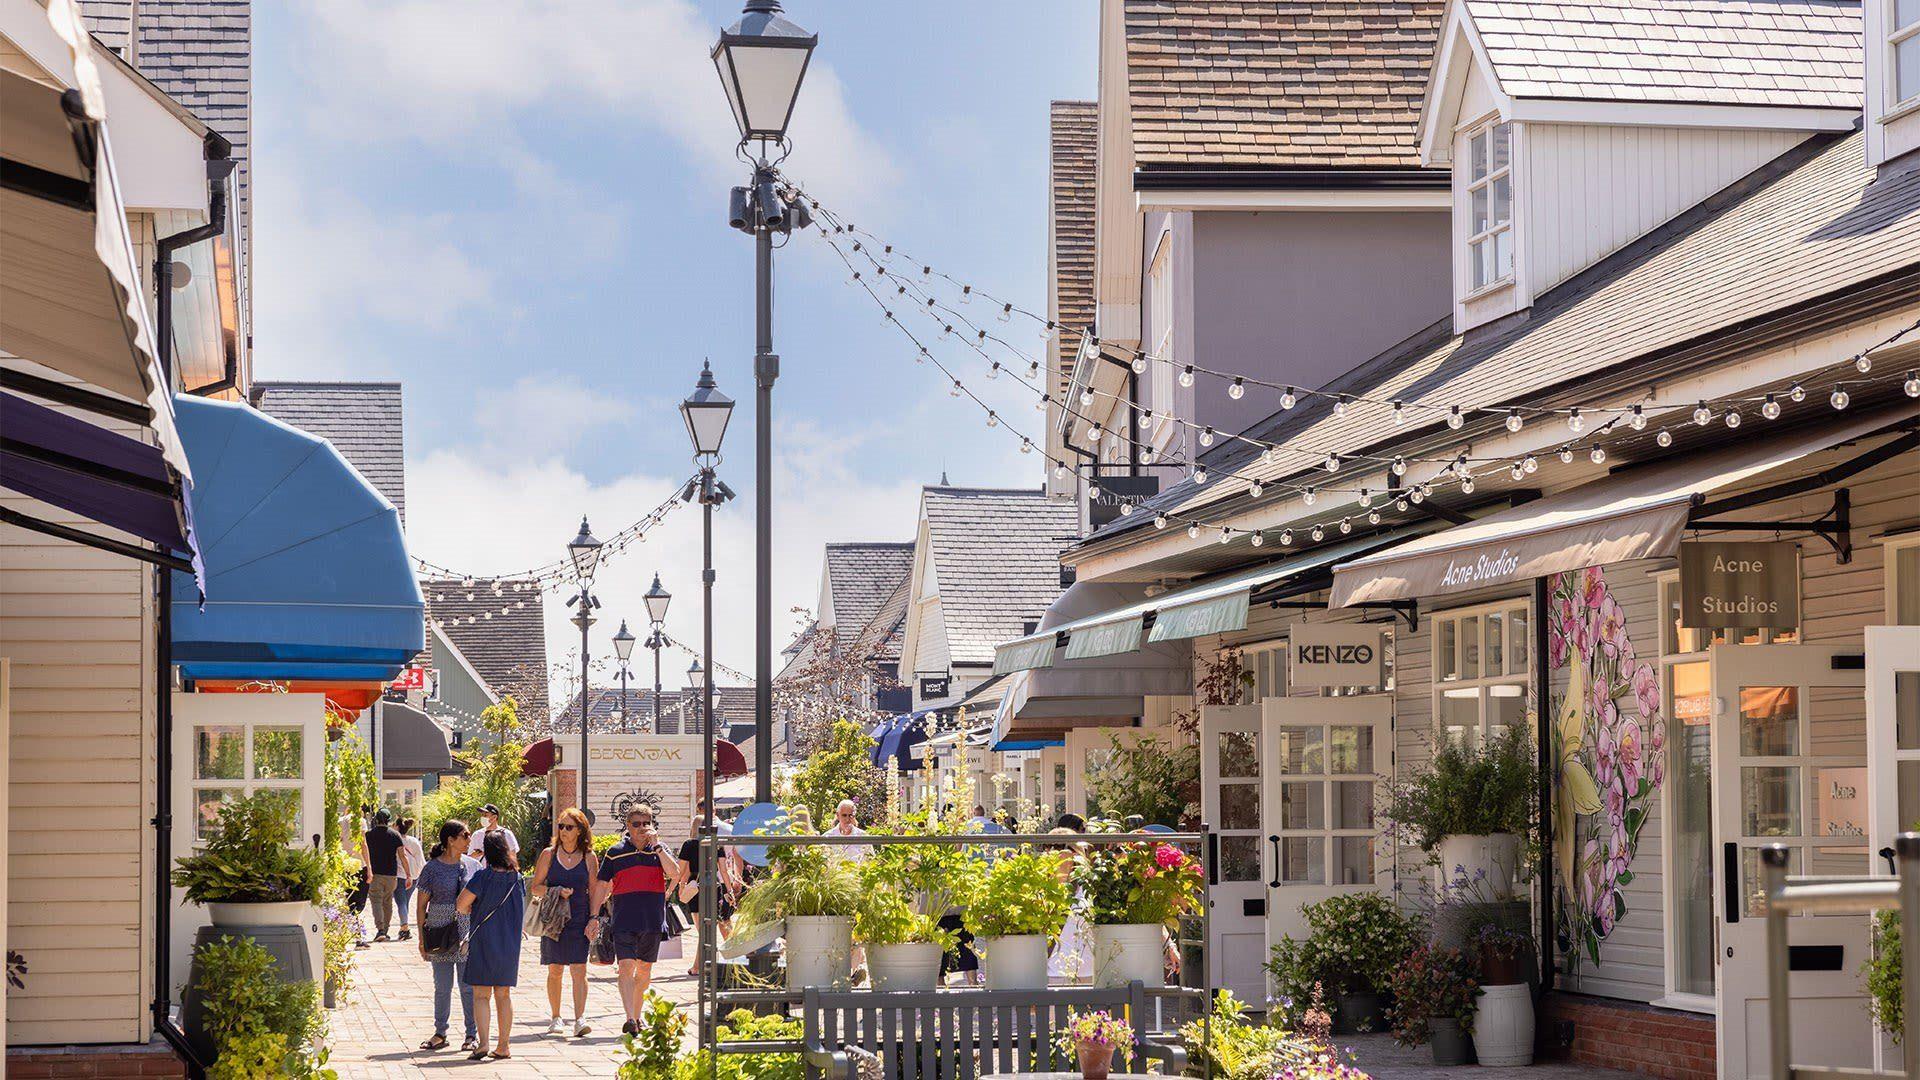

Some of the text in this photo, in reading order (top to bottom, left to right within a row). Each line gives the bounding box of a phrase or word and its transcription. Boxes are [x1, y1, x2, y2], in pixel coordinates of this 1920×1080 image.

[1441, 548, 1519, 586] Acne Studios
[1713, 554, 1763, 573] Acne
[1702, 595, 1778, 613] Studios
[1298, 644, 1373, 664] KENZO
[590, 748, 682, 760] BERENJAK
[1830, 781, 1856, 800] Acne
